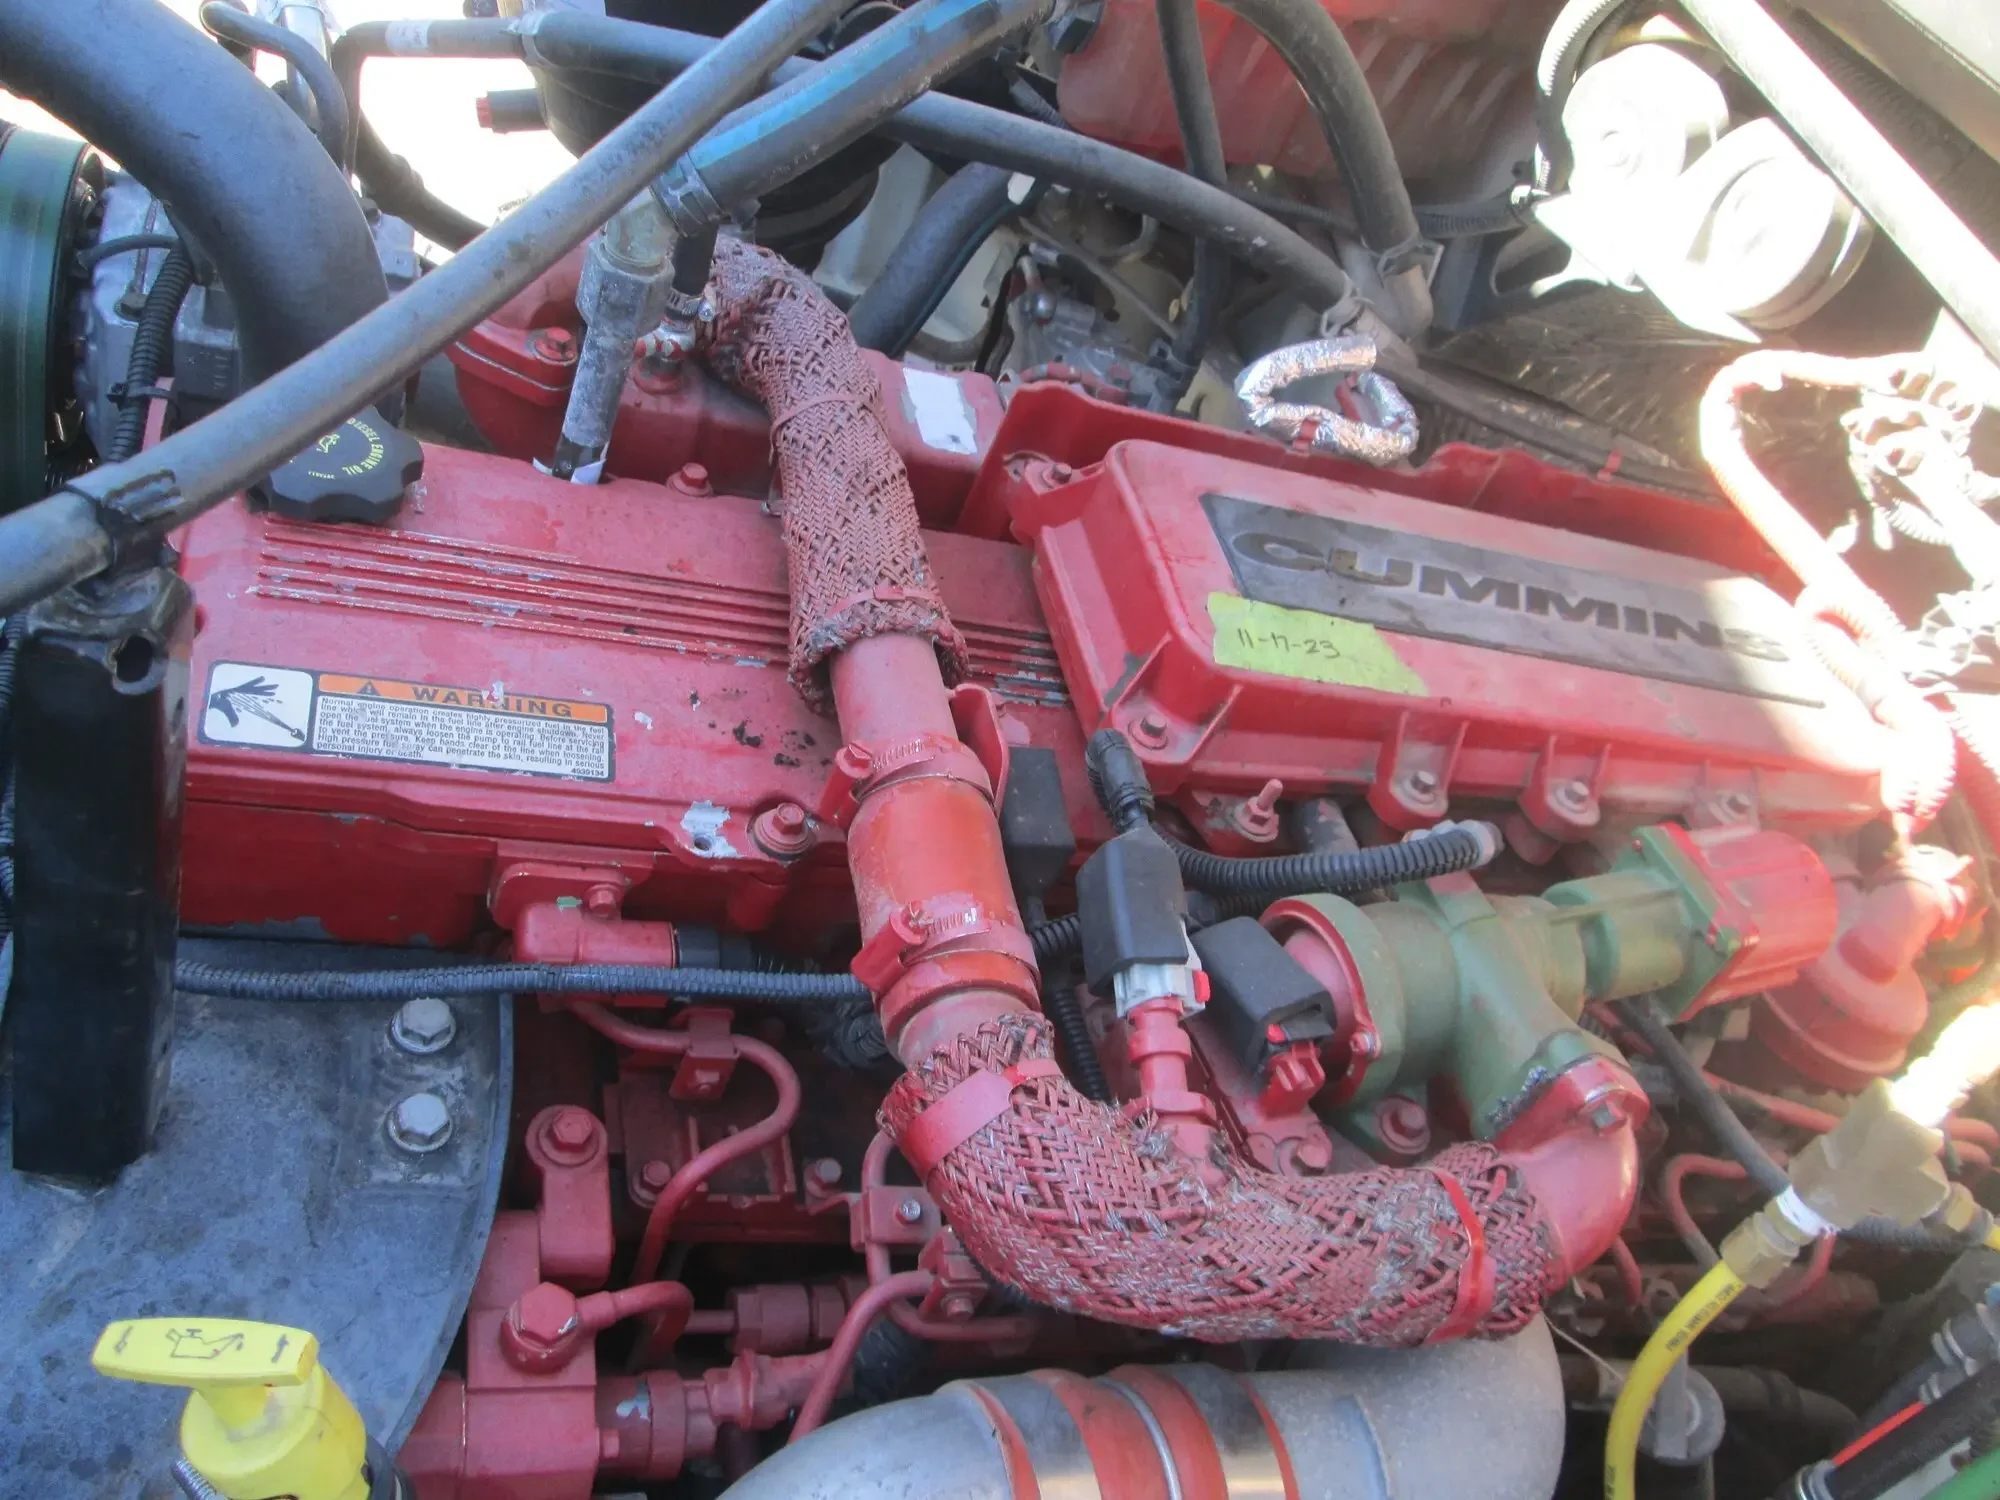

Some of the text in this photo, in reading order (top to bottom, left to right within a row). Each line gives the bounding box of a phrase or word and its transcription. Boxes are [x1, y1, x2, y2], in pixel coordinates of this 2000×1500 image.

[342, 417, 384, 476] DIESEL ENGINE OIL
[1231, 532, 1789, 662] CUMMINS
[1237, 628, 1340, 659] 11-17-23
[321, 697, 353, 706] Normal
[357, 701, 385, 711] engine
[389, 705, 429, 716] operation
[432, 709, 462, 718] creates
[466, 713, 490, 722] highly
[494, 716, 541, 728] pressurized
[340, 706, 364, 714] whic
[387, 711, 416, 719] remain
[484, 721, 503, 729] after
[506, 724, 533, 733] engine
[537, 727, 578, 737] shutdown.
[581, 732, 604, 740] Never
[320, 712, 341, 720] open
[380, 717, 410, 727] system
[414, 721, 436, 729] when
[455, 725, 482, 735] engine
[495, 729, 535, 740] operating.
[540, 734, 565, 742] Before
[568, 737, 604, 748] servicing
[331, 727, 349, 735] vent
[415, 736, 435, 745] Keep
[439, 738, 463, 747] hands
[538, 749, 560, 757] when
[563, 751, 604, 763] loosening.
[393, 726, 423, 736] always
[426, 729, 453, 738] loosen
[474, 736, 497, 744] pump
[316, 741, 354, 752] personal
[358, 745, 382, 755] injury
[317, 733, 338, 743] High
[341, 737, 379, 747] pressure
[445, 747, 486, 758] penetrate
[526, 755, 561, 766] resulting
[575, 760, 604, 769] serious
[571, 767, 604, 776] 4939134
